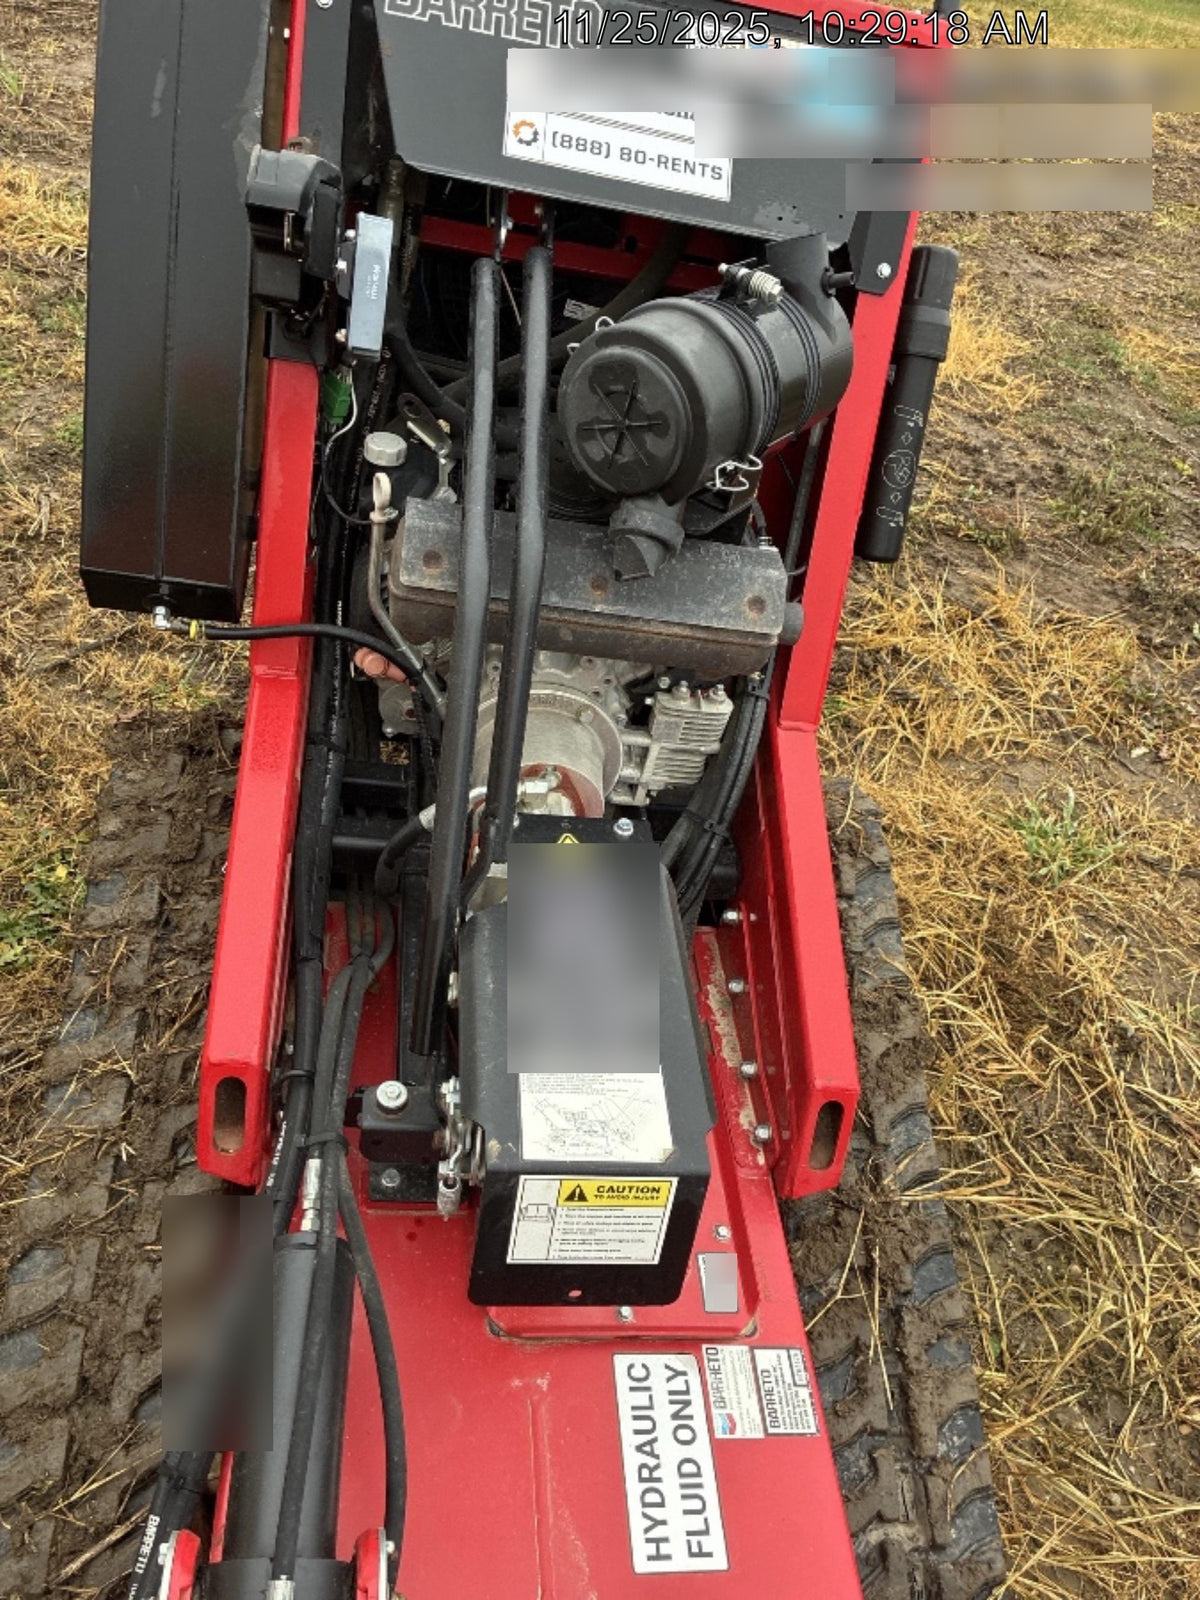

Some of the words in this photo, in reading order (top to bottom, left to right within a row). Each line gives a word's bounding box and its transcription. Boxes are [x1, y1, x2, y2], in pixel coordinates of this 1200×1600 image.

[551, 130, 611, 159] (888)
[619, 146, 723, 181] 80-RENTS
[597, 1185, 661, 1194] CAUTION
[664, 1363, 697, 1446] ONLY
[705, 1347, 728, 1409] BARRETO
[760, 1369, 781, 1429] BARRETO
[627, 1362, 672, 1562] HYDRAULIC
[677, 1457, 714, 1558] FLUID
